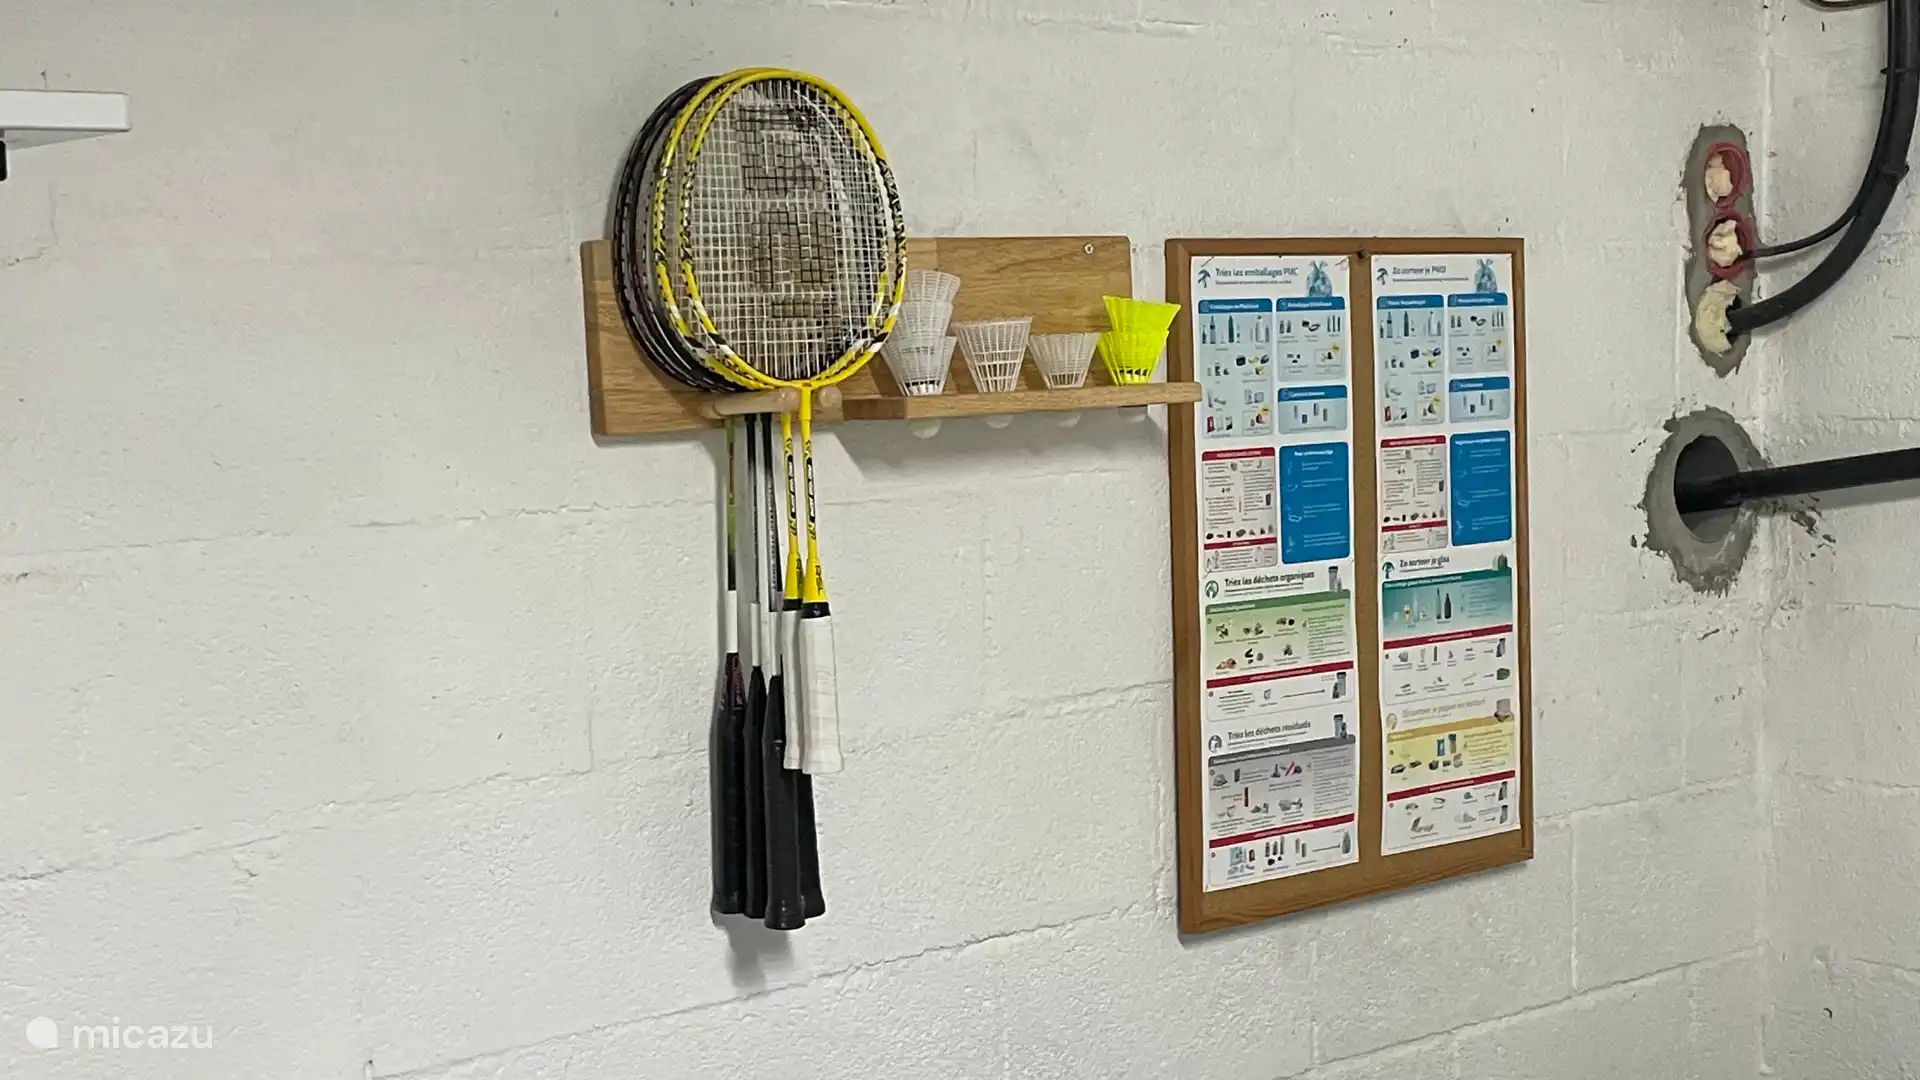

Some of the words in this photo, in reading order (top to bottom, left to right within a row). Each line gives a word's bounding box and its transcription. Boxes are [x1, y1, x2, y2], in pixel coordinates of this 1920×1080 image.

[1224, 578, 1242, 587] Triez
[1242, 576, 1252, 585] les
[1253, 574, 1279, 584] déchets
[1280, 571, 1315, 582] organiques
[1227, 731, 1244, 740] Triez
[1255, 725, 1281, 736] déchets
